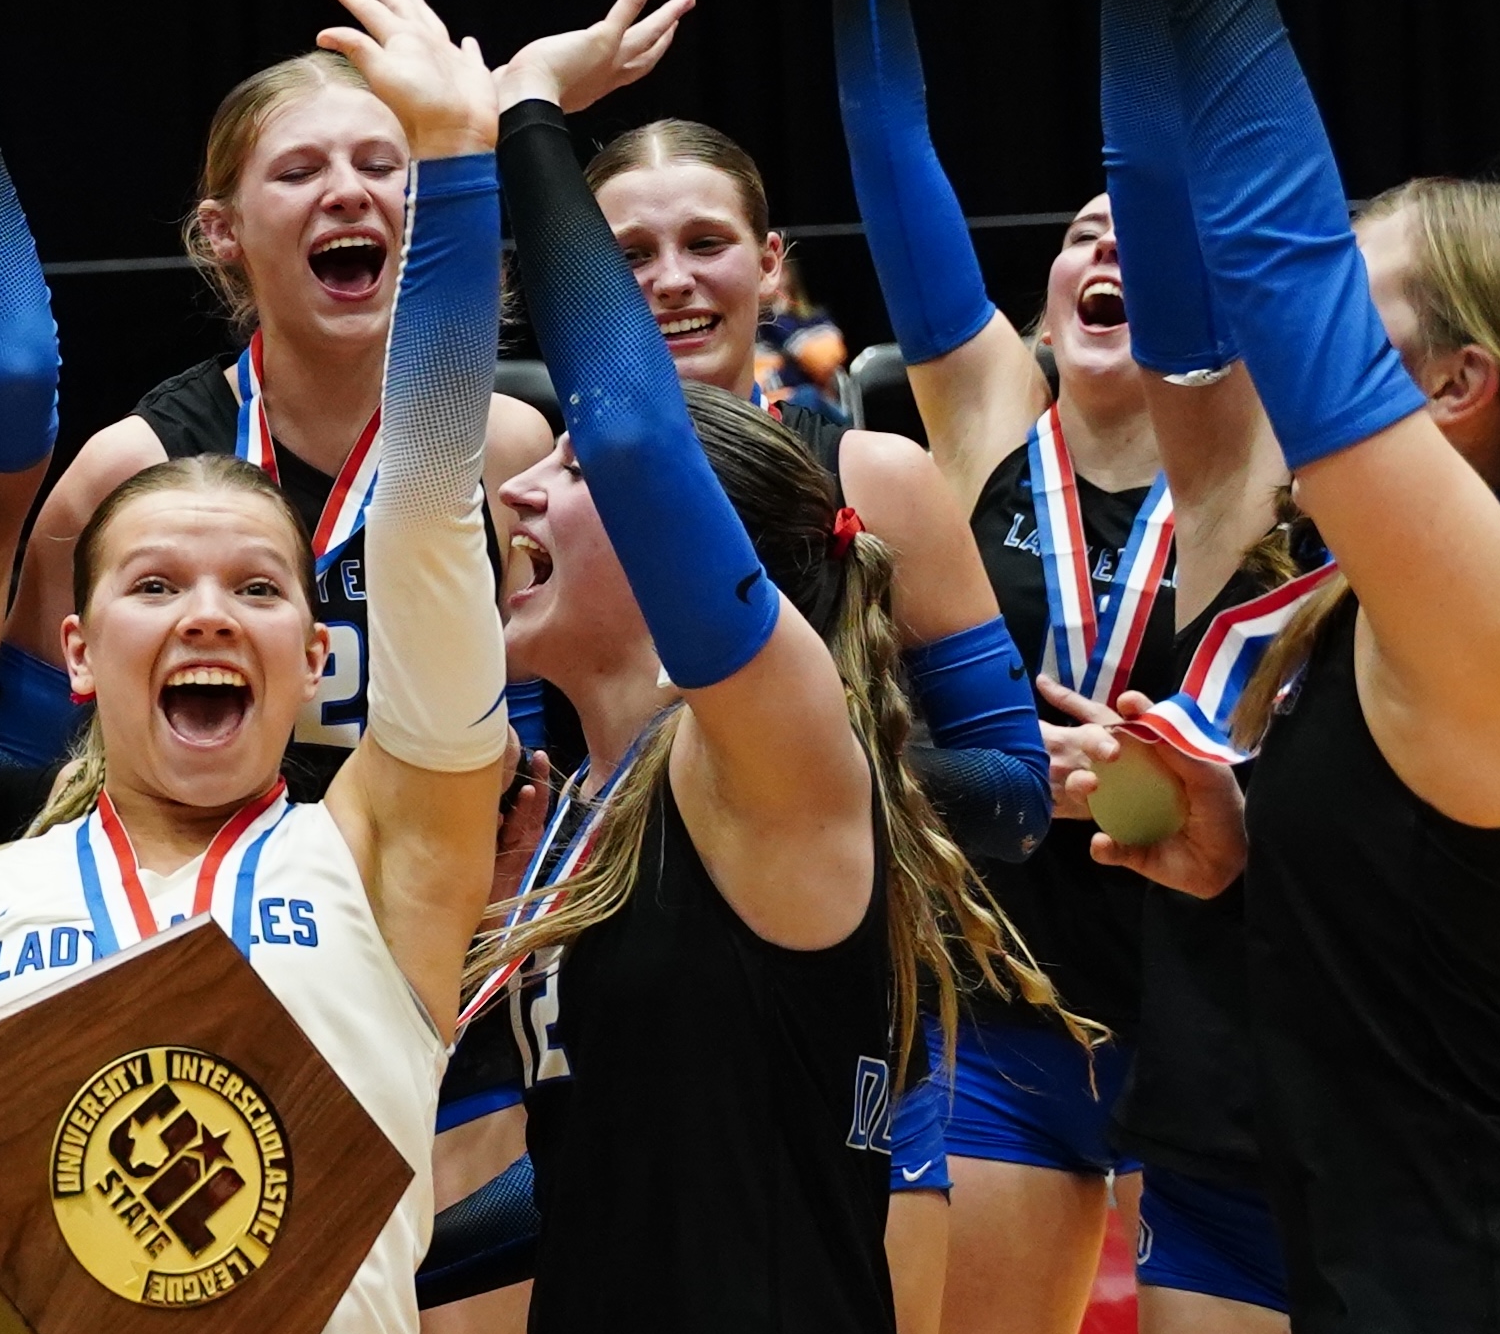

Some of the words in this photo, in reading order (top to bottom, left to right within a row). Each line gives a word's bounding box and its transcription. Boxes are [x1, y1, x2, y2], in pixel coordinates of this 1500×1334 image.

[56, 1056, 144, 1194] UNIVERSITY
[171, 1052, 289, 1246] INTERSCHOLASTIC
[94, 1167, 173, 1261] STATE
[148, 1253, 250, 1304] LEAGUE
